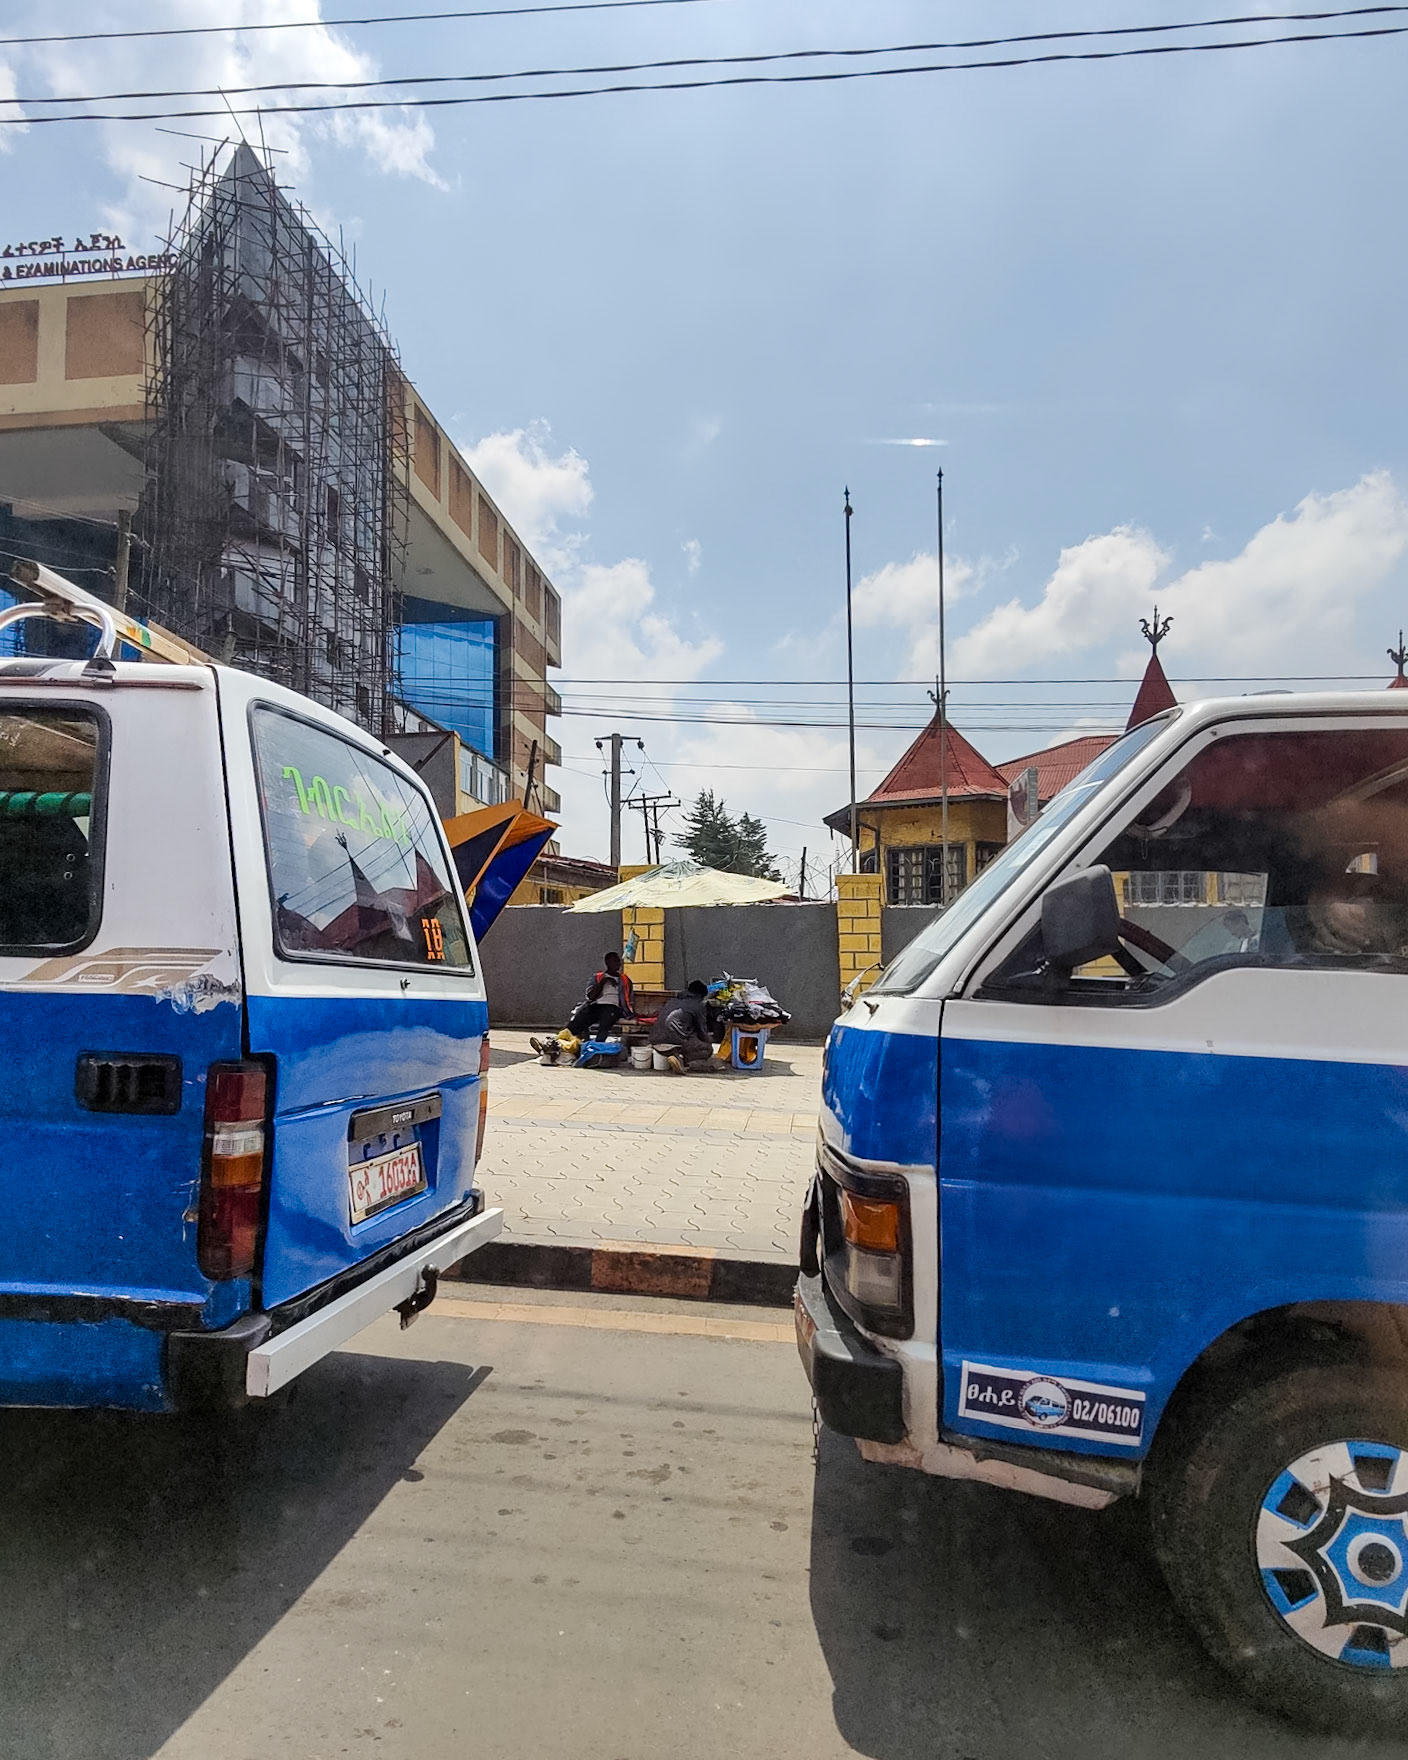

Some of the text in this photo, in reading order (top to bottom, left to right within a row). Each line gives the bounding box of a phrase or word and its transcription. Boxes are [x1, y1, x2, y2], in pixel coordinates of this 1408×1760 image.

[16, 257, 123, 278] EXAMINATIONS
[392, 1110, 412, 1124] TOYOTA
[967, 1383, 1016, 1407] ፀሐይ
[1072, 1399, 1141, 1429] 02/06100
